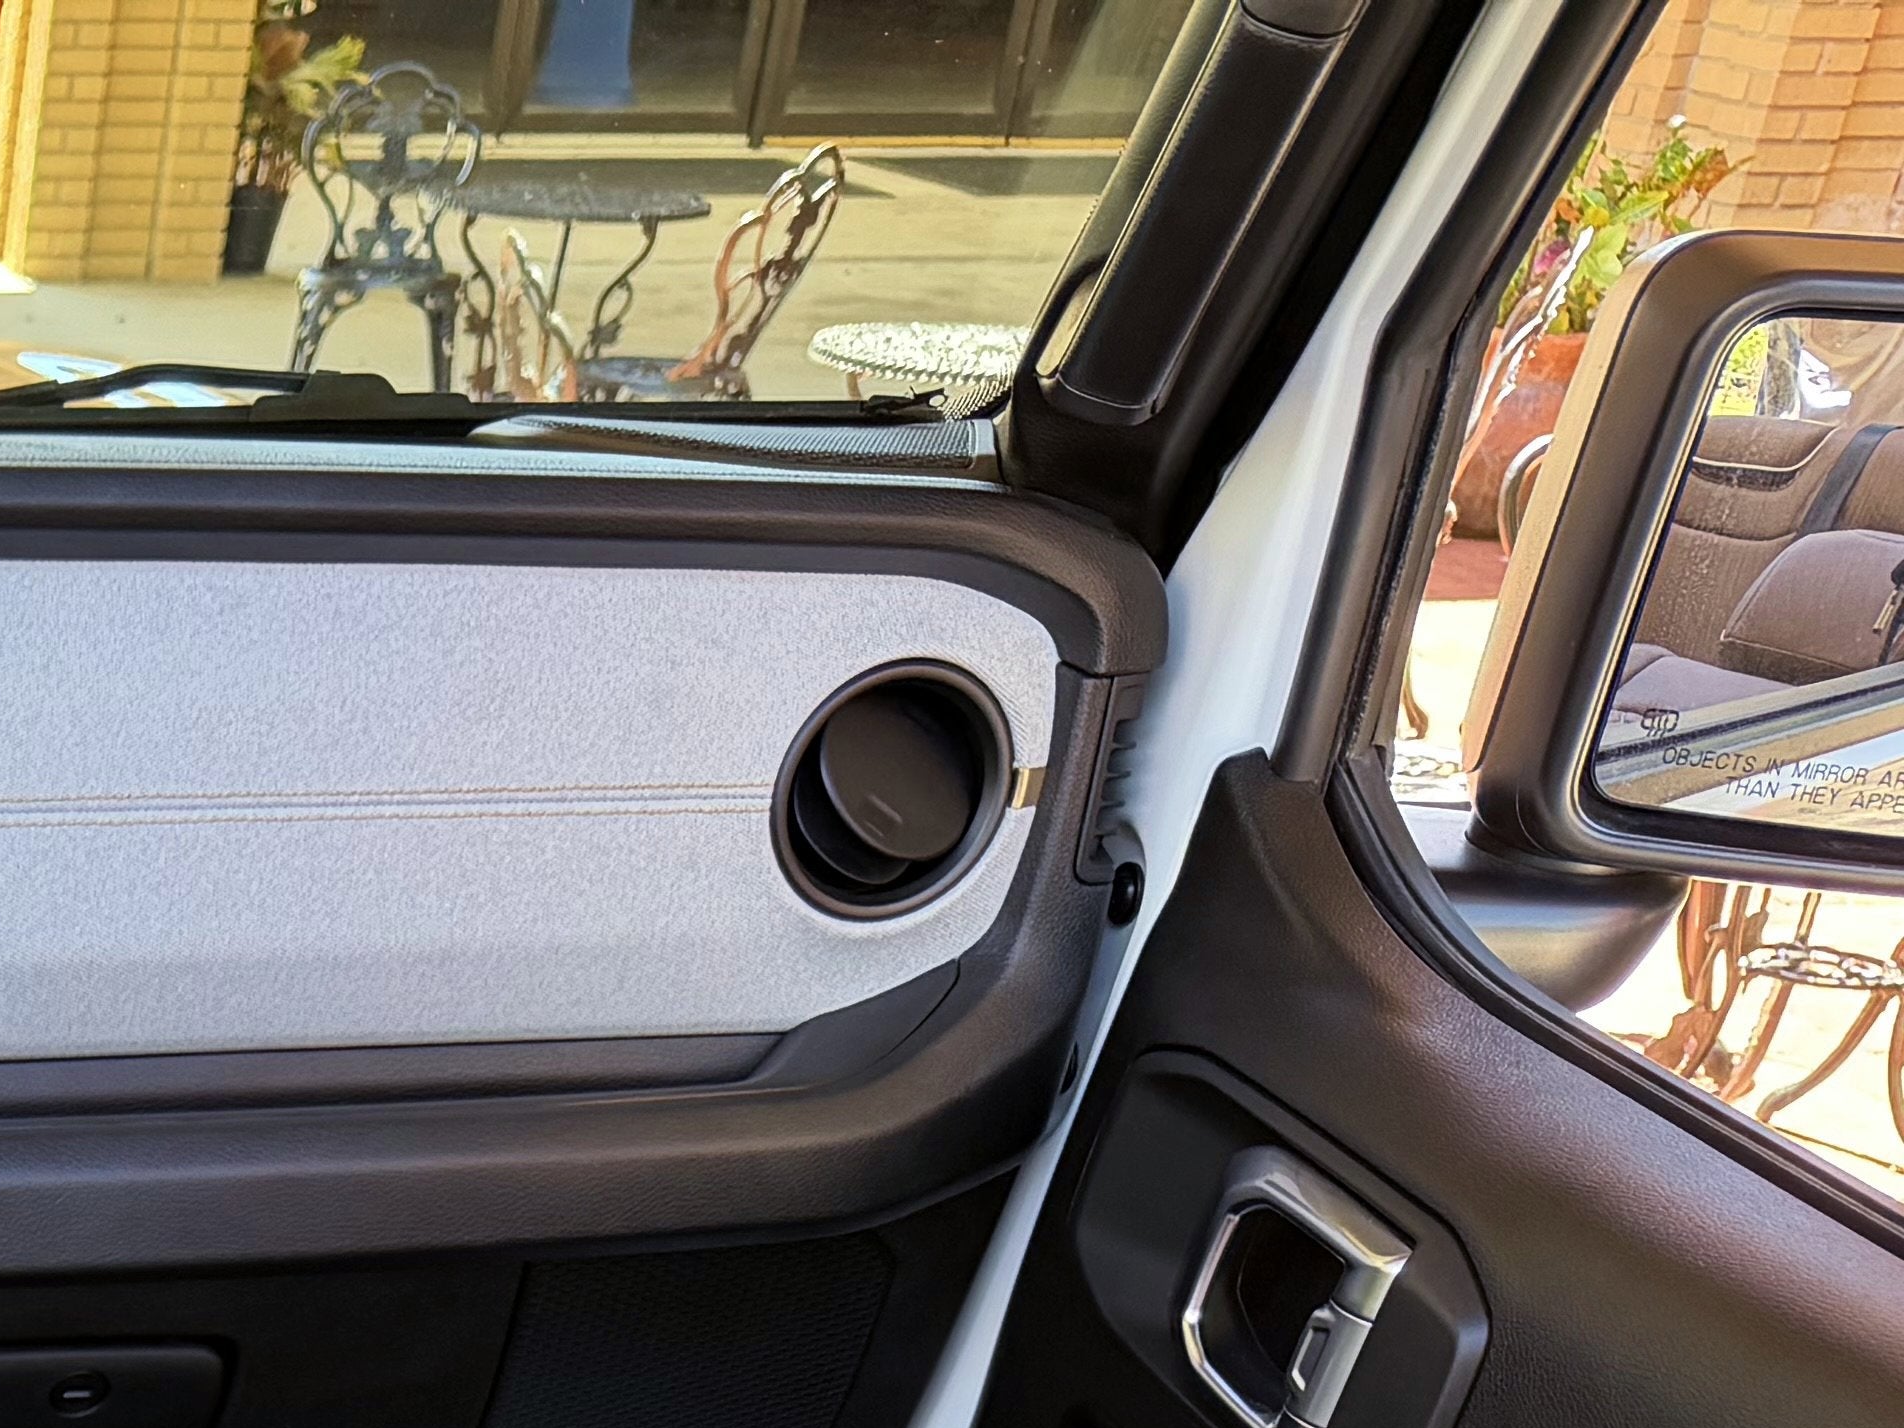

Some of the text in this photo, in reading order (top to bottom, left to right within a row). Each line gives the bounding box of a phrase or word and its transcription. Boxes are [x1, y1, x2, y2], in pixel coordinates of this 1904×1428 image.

[1663, 747, 1756, 773] OBJECTS
[1764, 758, 1783, 776] IN
[1791, 762, 1869, 786] MIRROR
[1725, 775, 1780, 799] THAN
[1791, 783, 1842, 806] THEY
